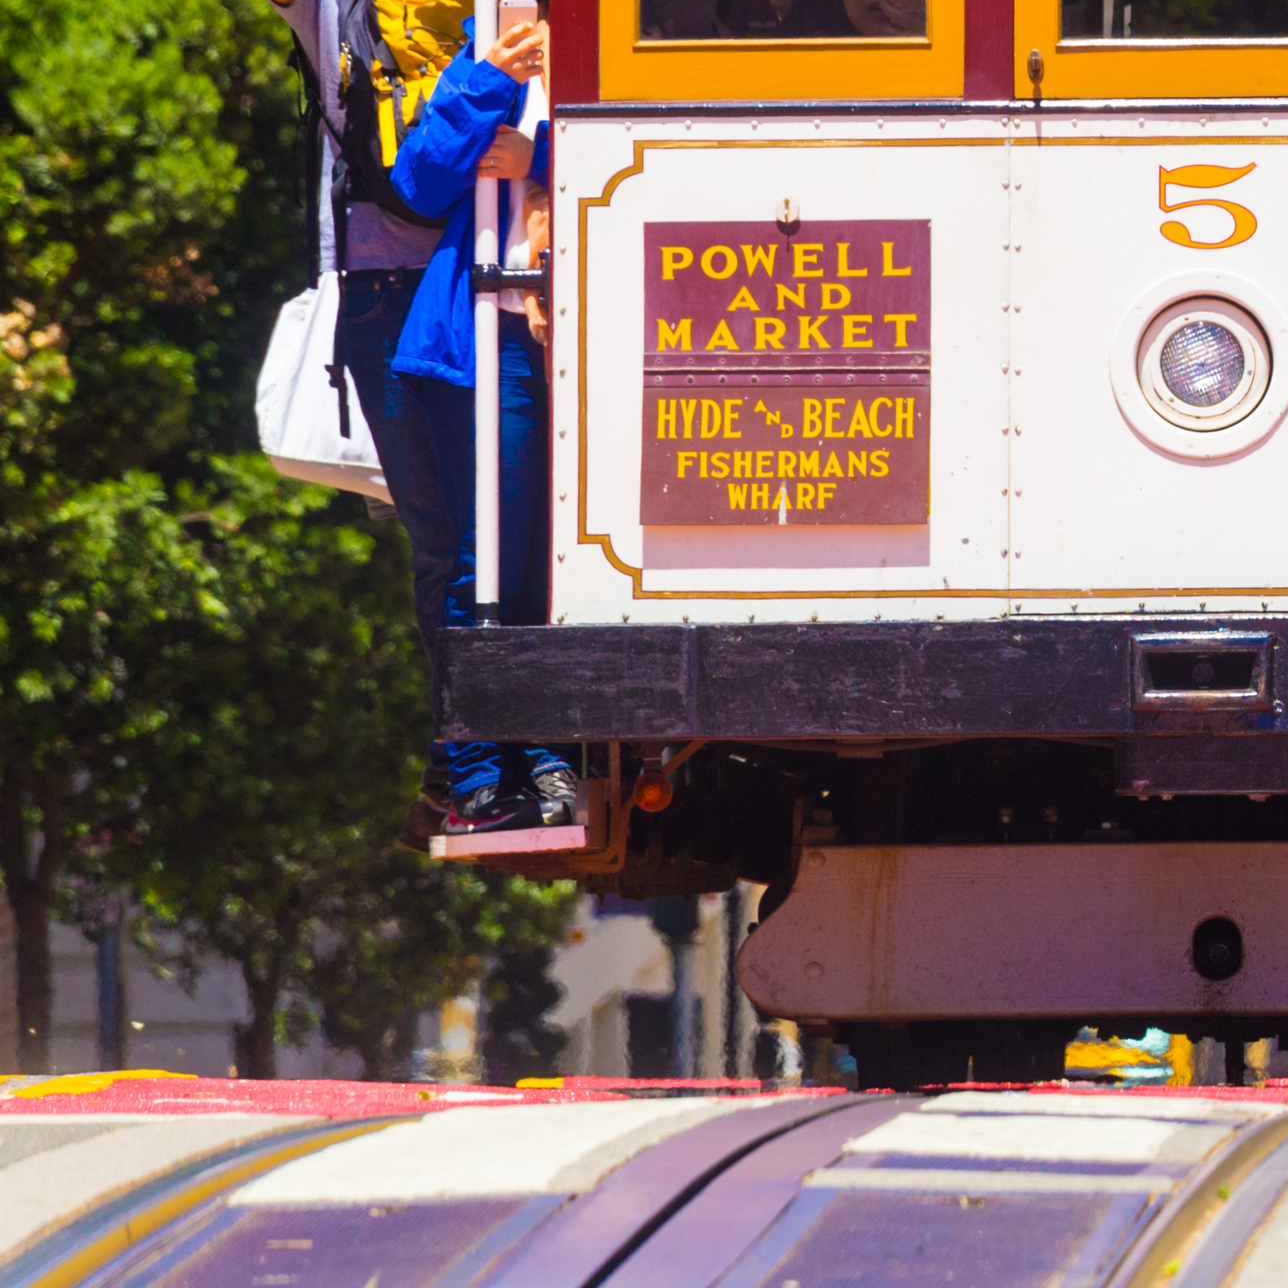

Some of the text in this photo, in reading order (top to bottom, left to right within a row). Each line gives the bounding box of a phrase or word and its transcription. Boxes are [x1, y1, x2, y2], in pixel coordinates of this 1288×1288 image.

[1159, 161, 1258, 250] 5
[660, 242, 911, 280] POWELL
[727, 283, 852, 311] AND
[657, 314, 917, 351] MARKET
[657, 397, 915, 439] HYDE AND BEACH
[676, 450, 890, 479] FISHERMANS
[727, 482, 838, 510] WHARF
